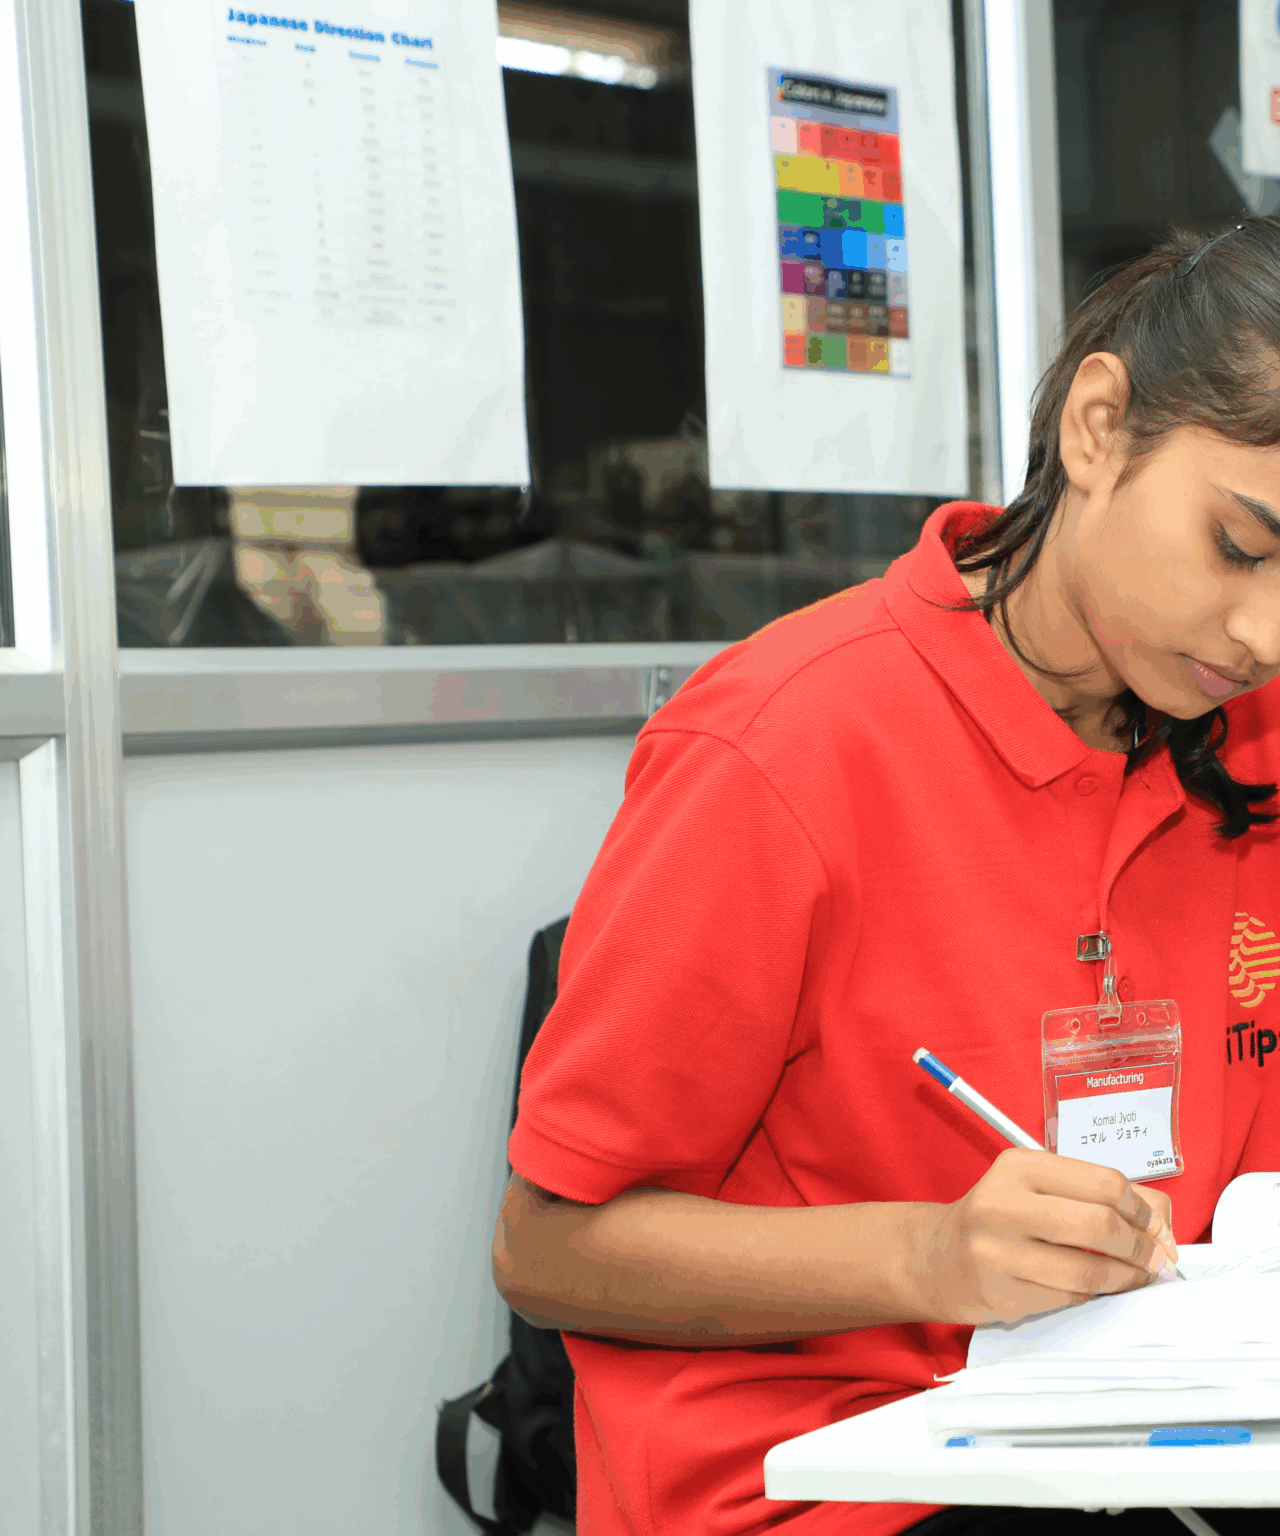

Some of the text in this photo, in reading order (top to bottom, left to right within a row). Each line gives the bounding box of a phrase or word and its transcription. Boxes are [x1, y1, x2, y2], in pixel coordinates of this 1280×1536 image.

[228, 7, 433, 50] Japanese Direction Chart
[1086, 1072, 1144, 1088] Manufacturing
[1092, 1111, 1137, 1127] Komal Jyoti
[1081, 1126, 1148, 1145] コマル ジョティ
[1147, 1157, 1173, 1168] oyakata
